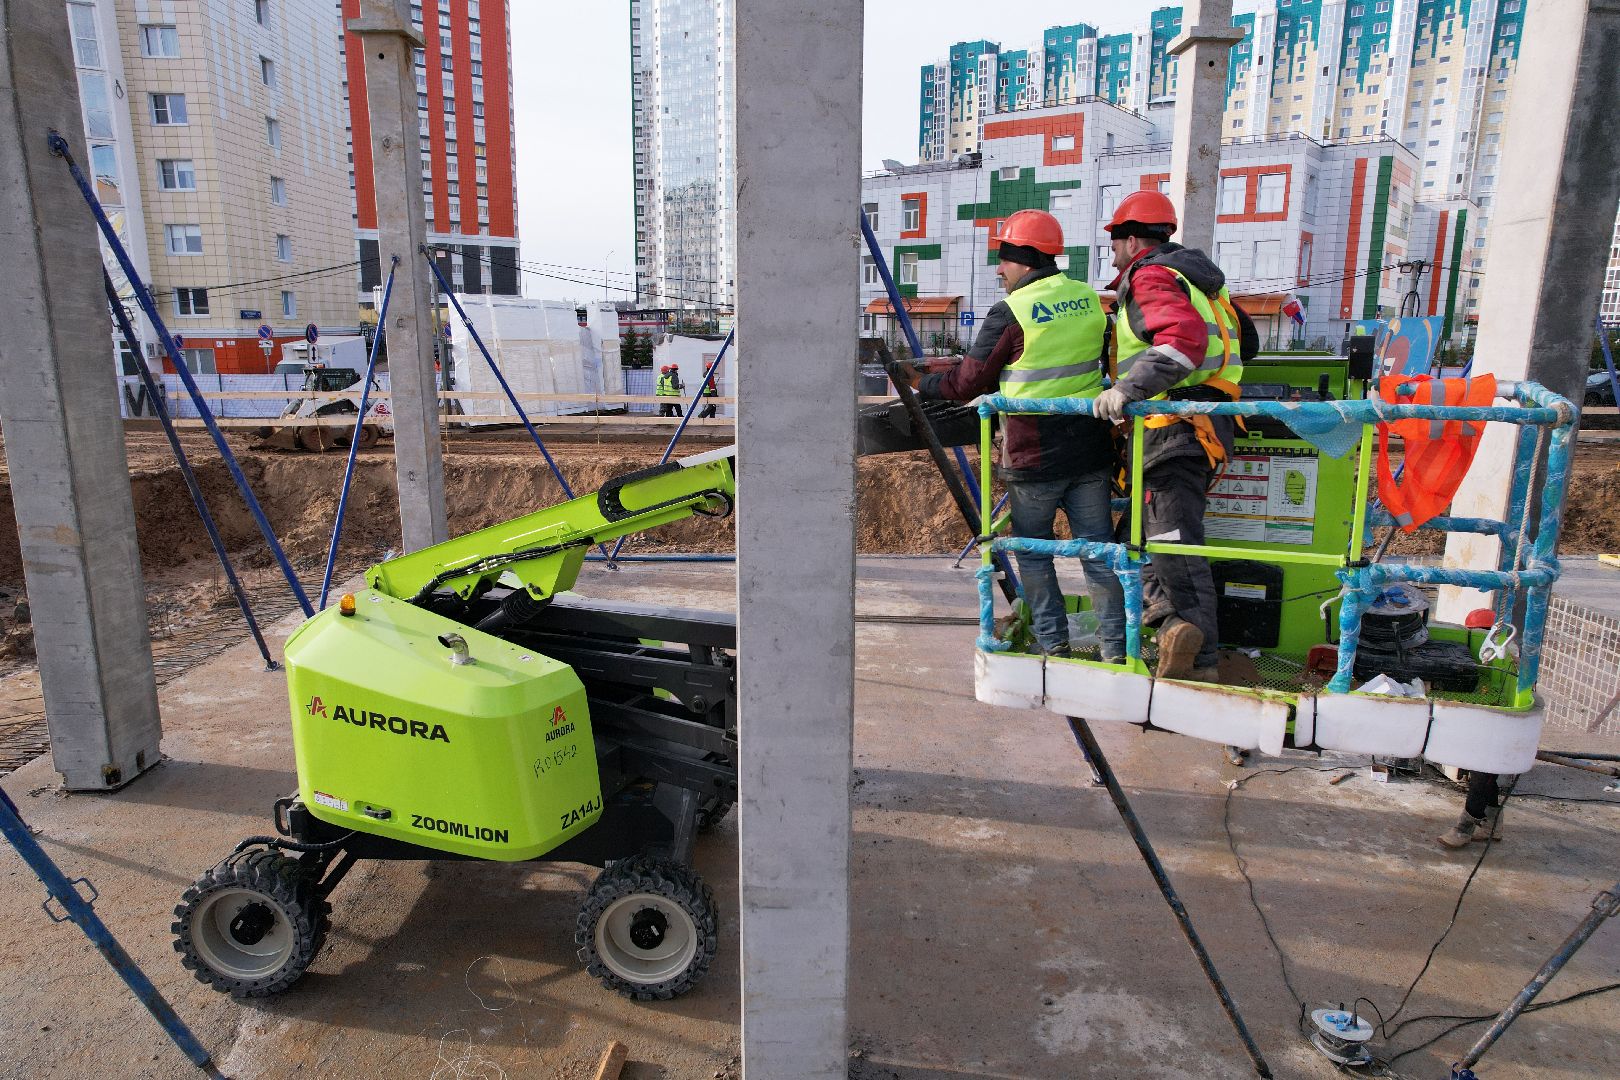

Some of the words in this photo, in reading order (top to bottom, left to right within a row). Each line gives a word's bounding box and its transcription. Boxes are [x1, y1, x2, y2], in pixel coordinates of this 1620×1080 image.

[1052, 297, 1090, 314] КРОСТ
[963, 313, 972, 325] P
[332, 704, 451, 744] AURORA
[545, 722, 576, 743] AURORA
[560, 795, 601, 831] ZA14J
[411, 814, 509, 844] ZOOMLION
